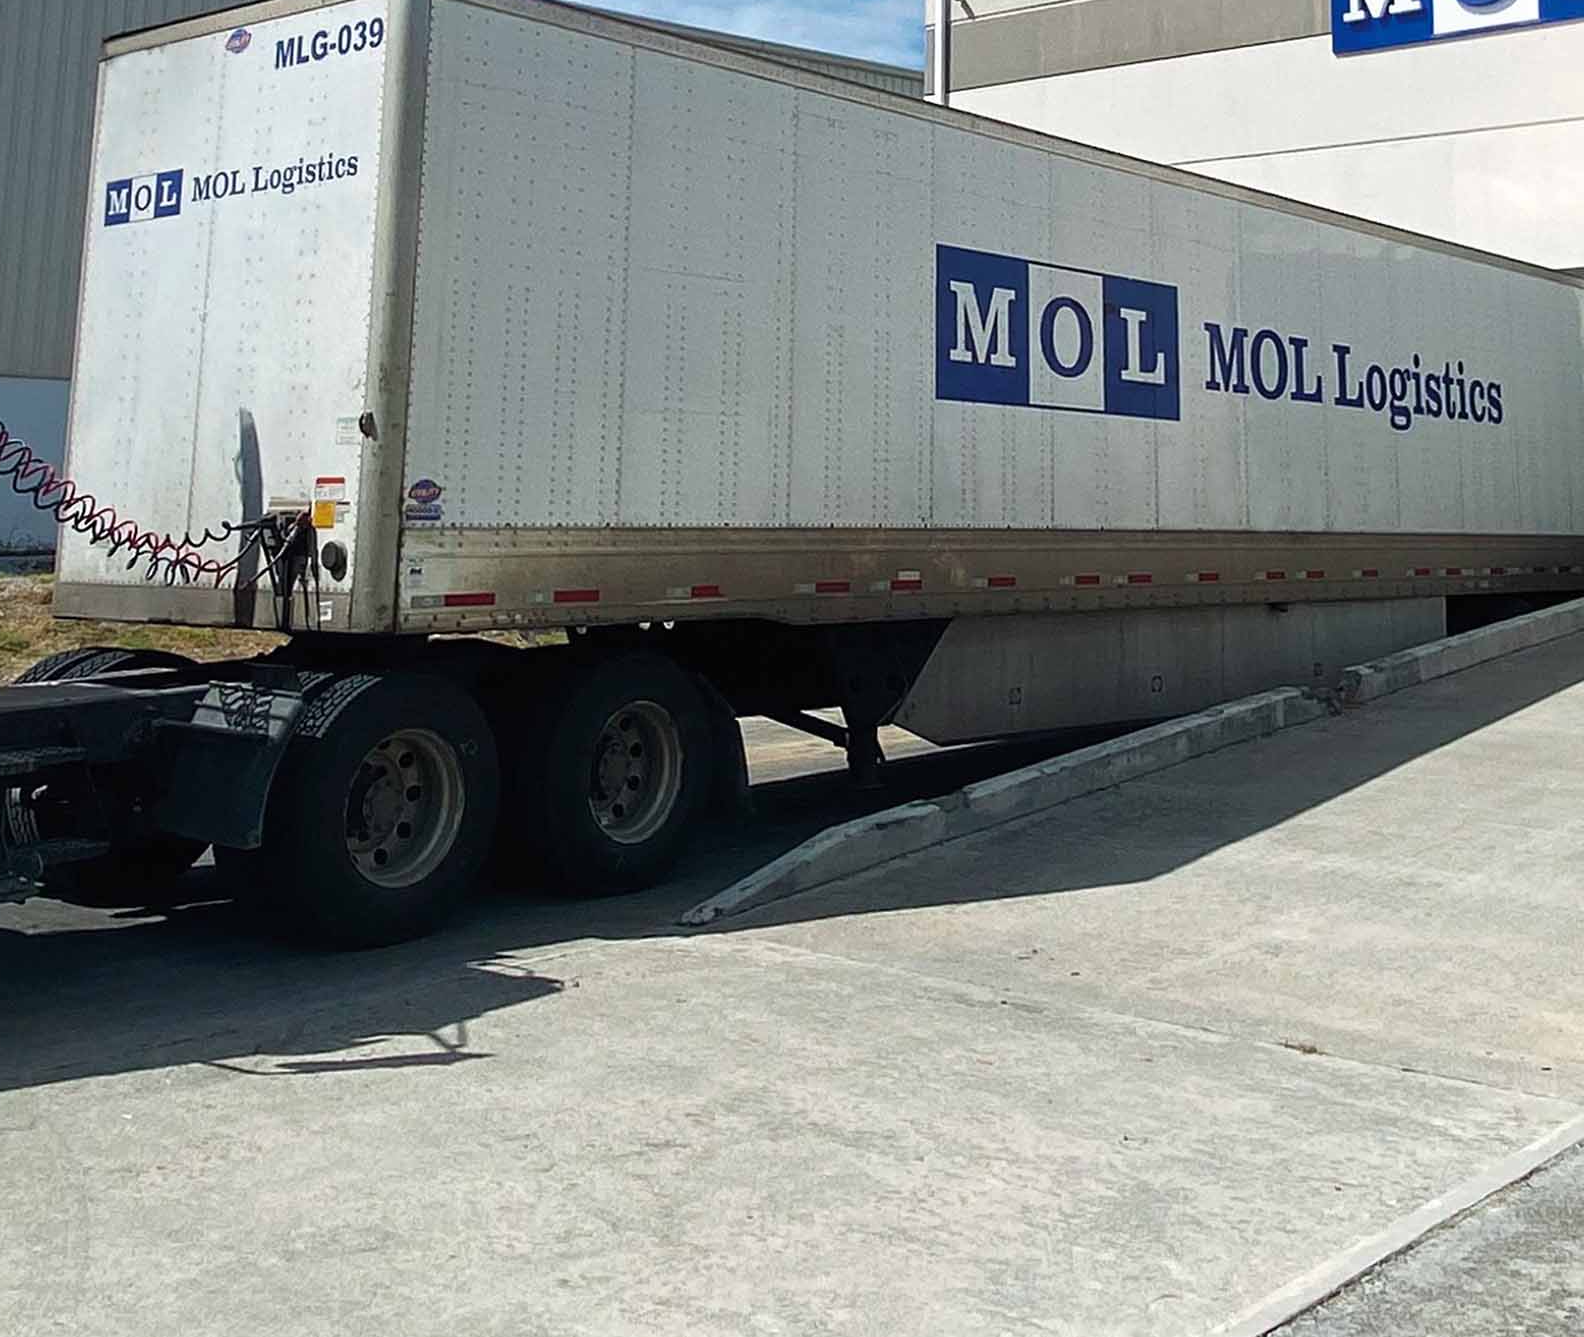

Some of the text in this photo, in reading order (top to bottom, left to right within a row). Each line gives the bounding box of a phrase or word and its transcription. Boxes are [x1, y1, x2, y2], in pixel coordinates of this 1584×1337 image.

[274, 17, 384, 70] MLG-039
[108, 152, 359, 215] MOL MOL Logistics
[948, 280, 1504, 431] MOL MOL Logistics
